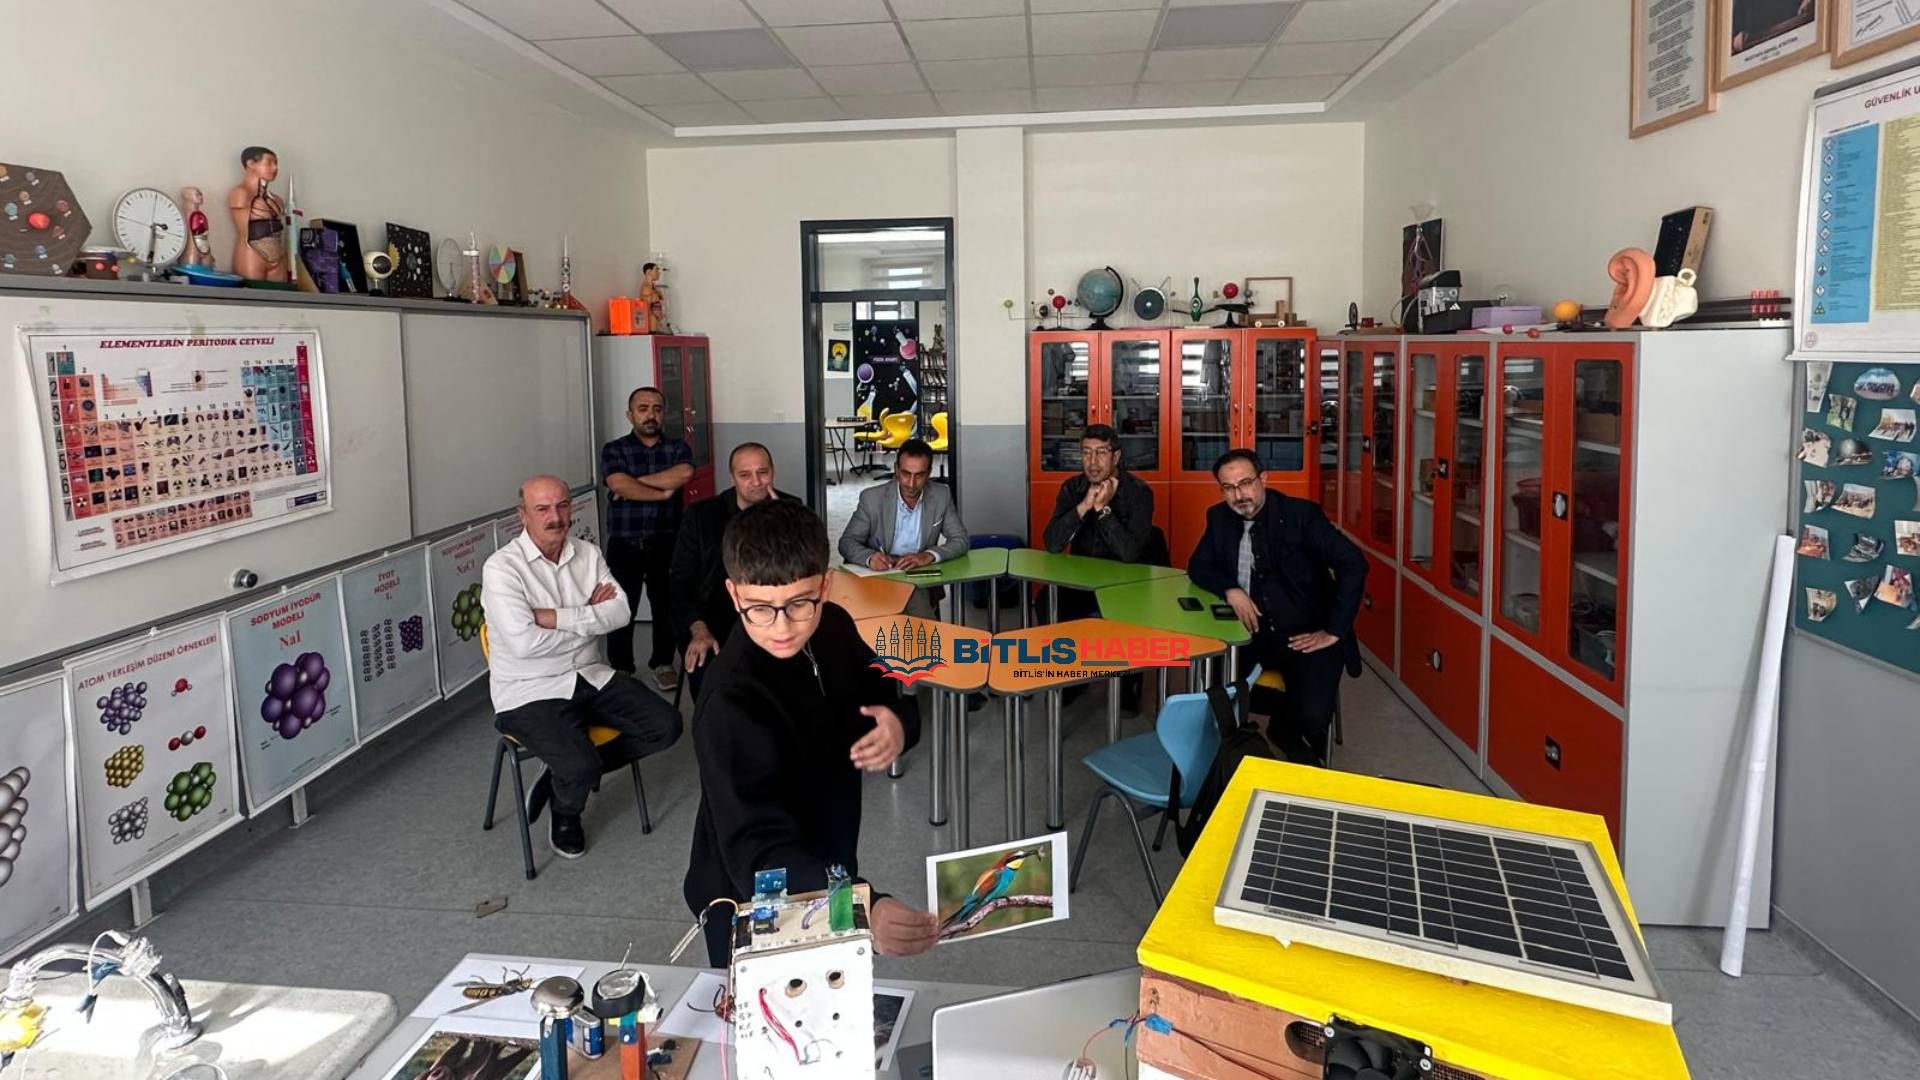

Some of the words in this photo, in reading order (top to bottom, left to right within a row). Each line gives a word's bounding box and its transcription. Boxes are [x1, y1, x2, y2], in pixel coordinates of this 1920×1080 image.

[1864, 87, 1912, 109] GÜVENLİK
[99, 338, 184, 349] ELEMENTLERİN
[250, 604, 289, 626] SODYUM
[272, 610, 304, 630] MODELİ
[78, 673, 105, 691] ATOM
[106, 659, 146, 679] YERLEŞİM
[147, 648, 176, 666] DÜZENİ
[176, 633, 217, 656] ÖRNEKLERİ
